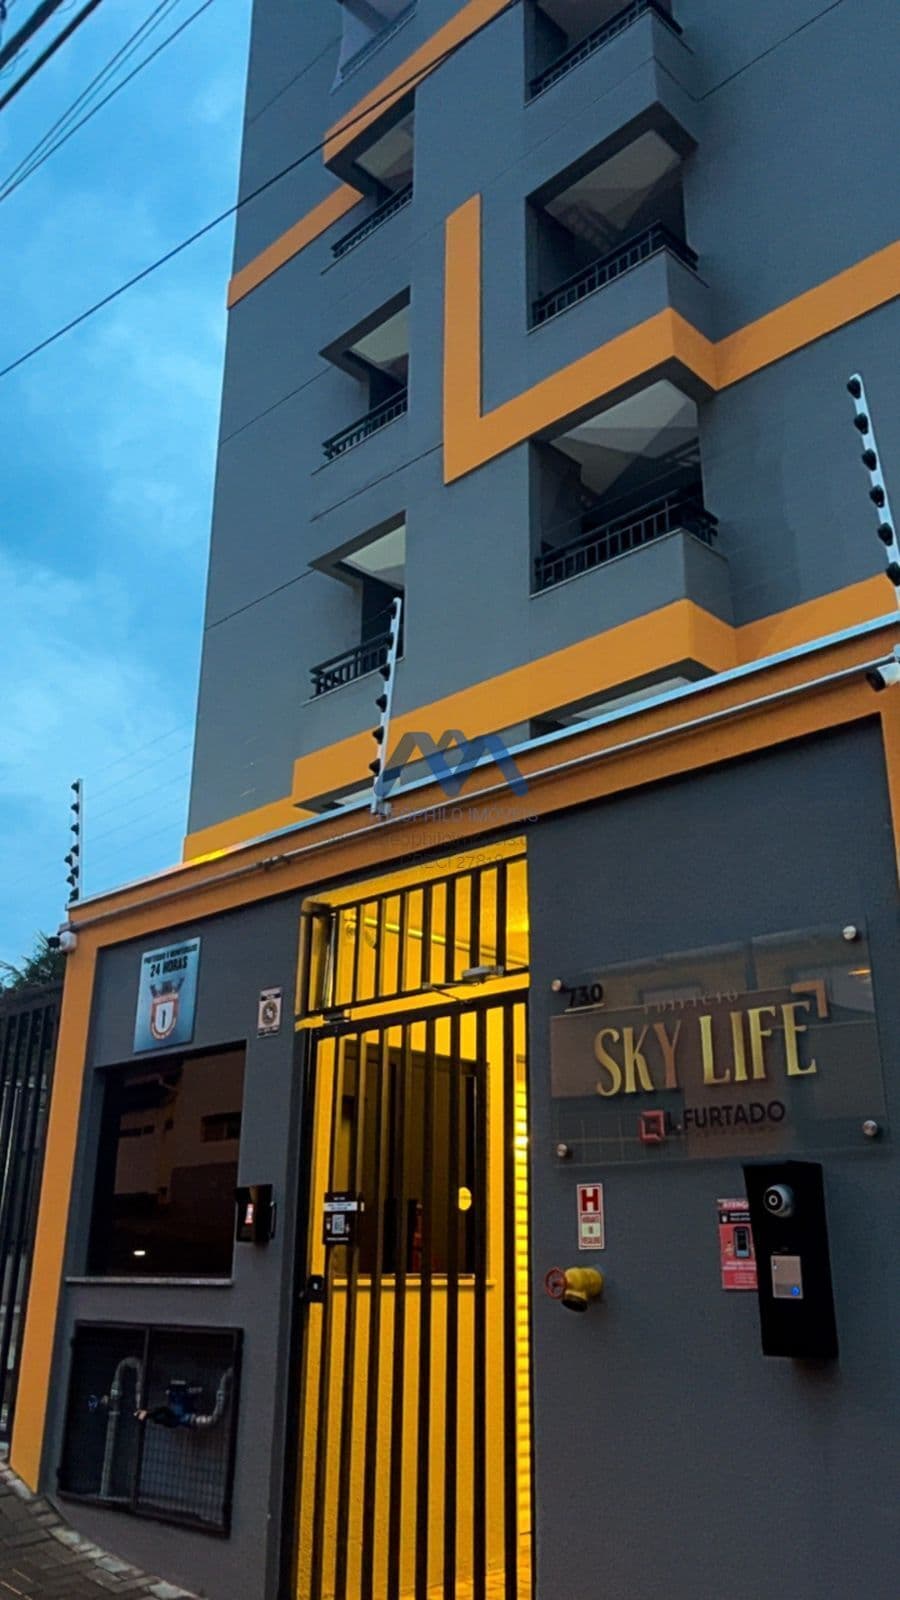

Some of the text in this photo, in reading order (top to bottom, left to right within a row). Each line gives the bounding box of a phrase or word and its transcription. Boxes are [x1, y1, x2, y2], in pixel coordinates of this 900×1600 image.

[150, 962, 161, 978] 24
[568, 983, 604, 1008] 730
[593, 1000, 817, 1097] SKY LIFE
[581, 1188, 600, 1212] H
